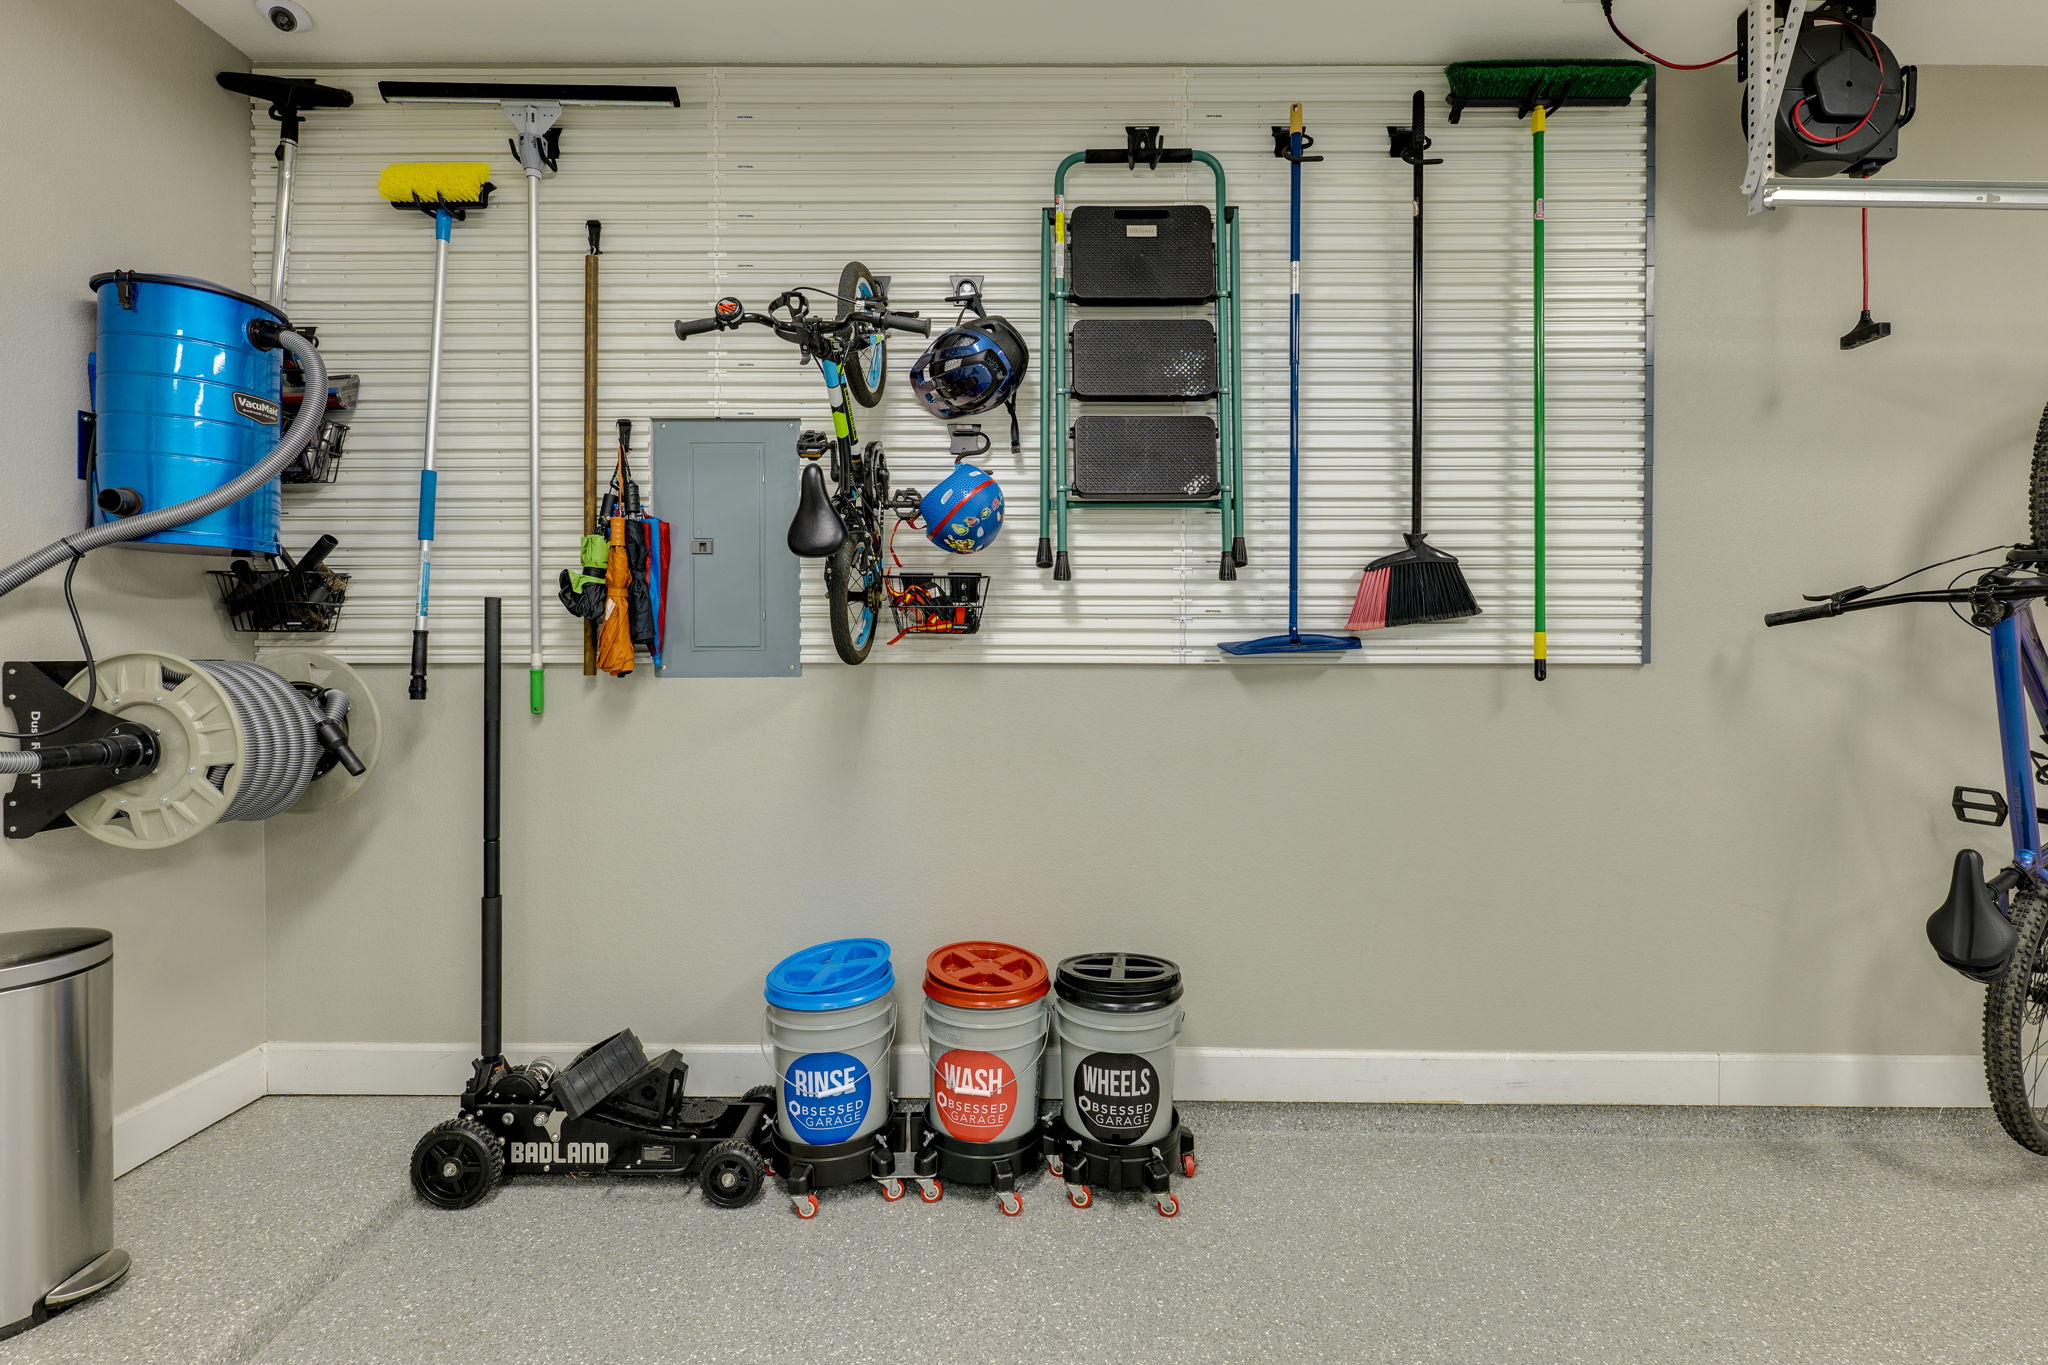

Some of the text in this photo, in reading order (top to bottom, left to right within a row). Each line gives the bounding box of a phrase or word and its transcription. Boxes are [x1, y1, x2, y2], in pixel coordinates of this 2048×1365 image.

[237, 397, 278, 416] VacuMaid
[31, 711, 41, 740] Dus
[795, 1066, 856, 1098] RINSE
[944, 1061, 1003, 1095] WASH
[1082, 1063, 1151, 1097] WHEELS
[805, 1110, 861, 1127] GARAGE
[950, 1110, 1005, 1125] GARAGE
[1095, 1113, 1150, 1126] GARAGE
[510, 1142, 609, 1164] BADLAND
